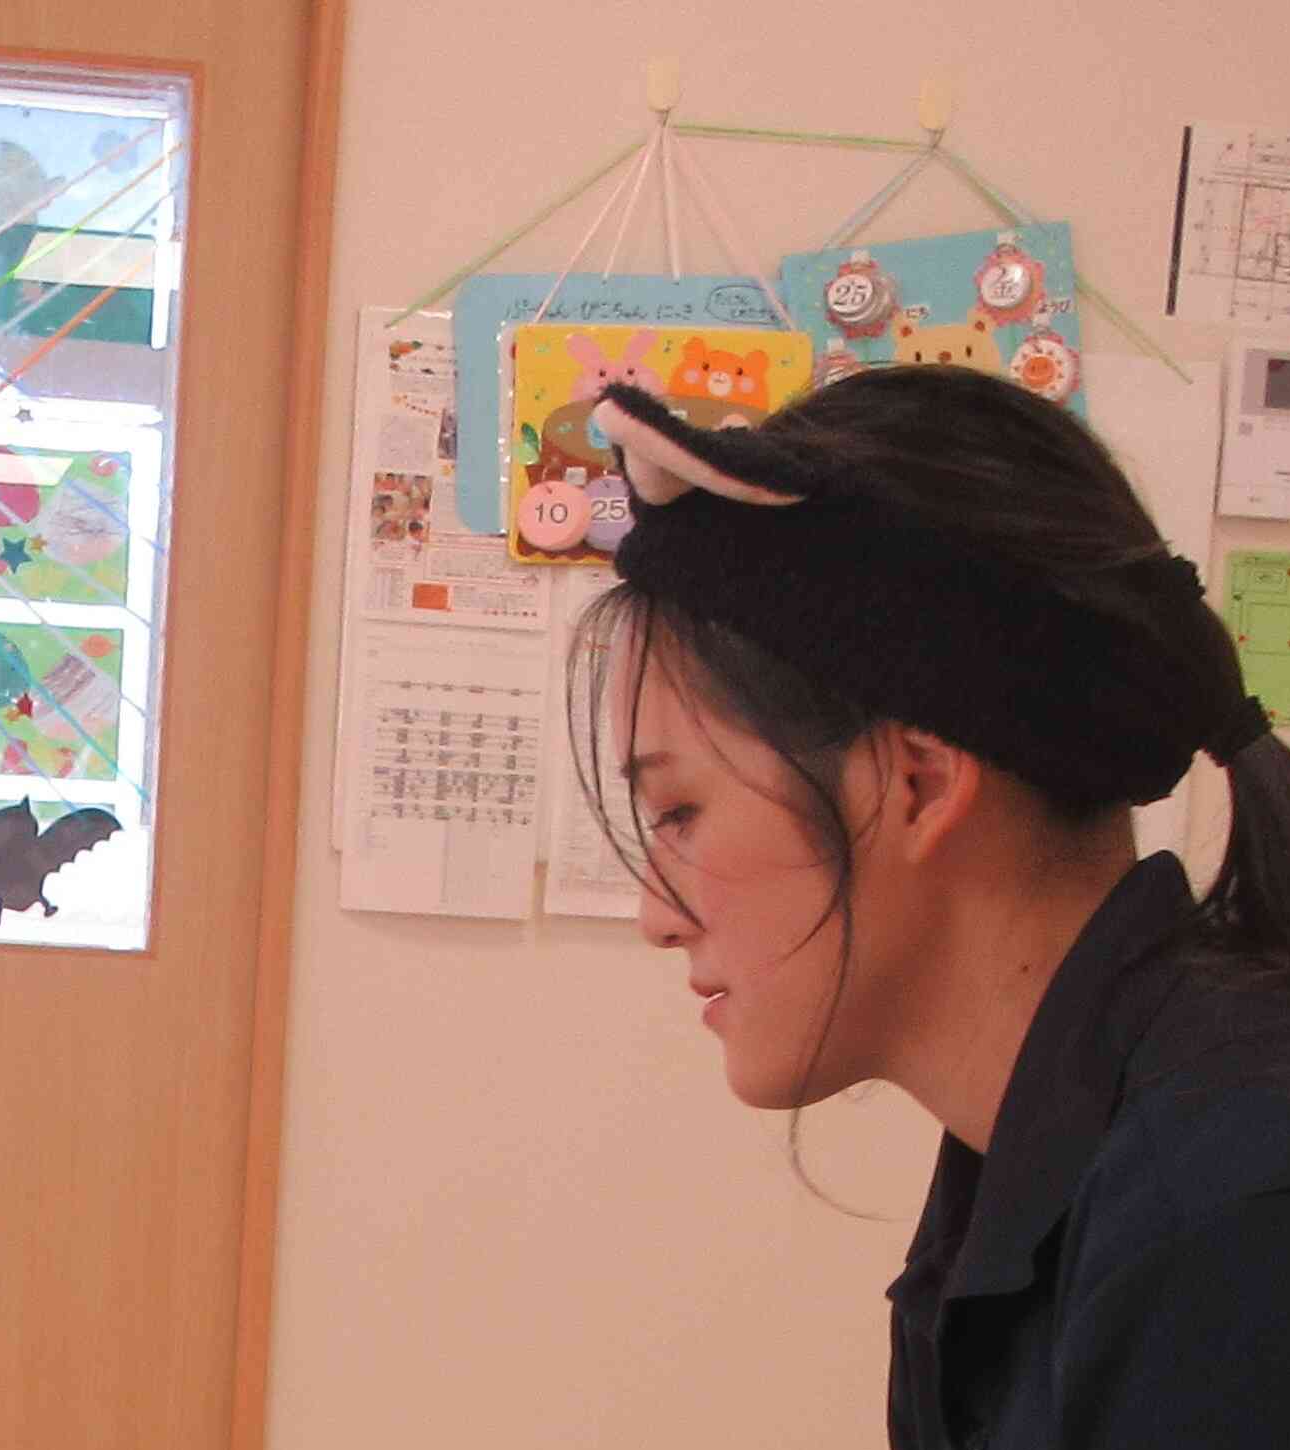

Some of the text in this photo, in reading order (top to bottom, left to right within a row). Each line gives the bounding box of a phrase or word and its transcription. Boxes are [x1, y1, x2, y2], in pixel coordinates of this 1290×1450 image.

[833, 283, 869, 306] 25
[534, 498, 628, 525] 10 25
